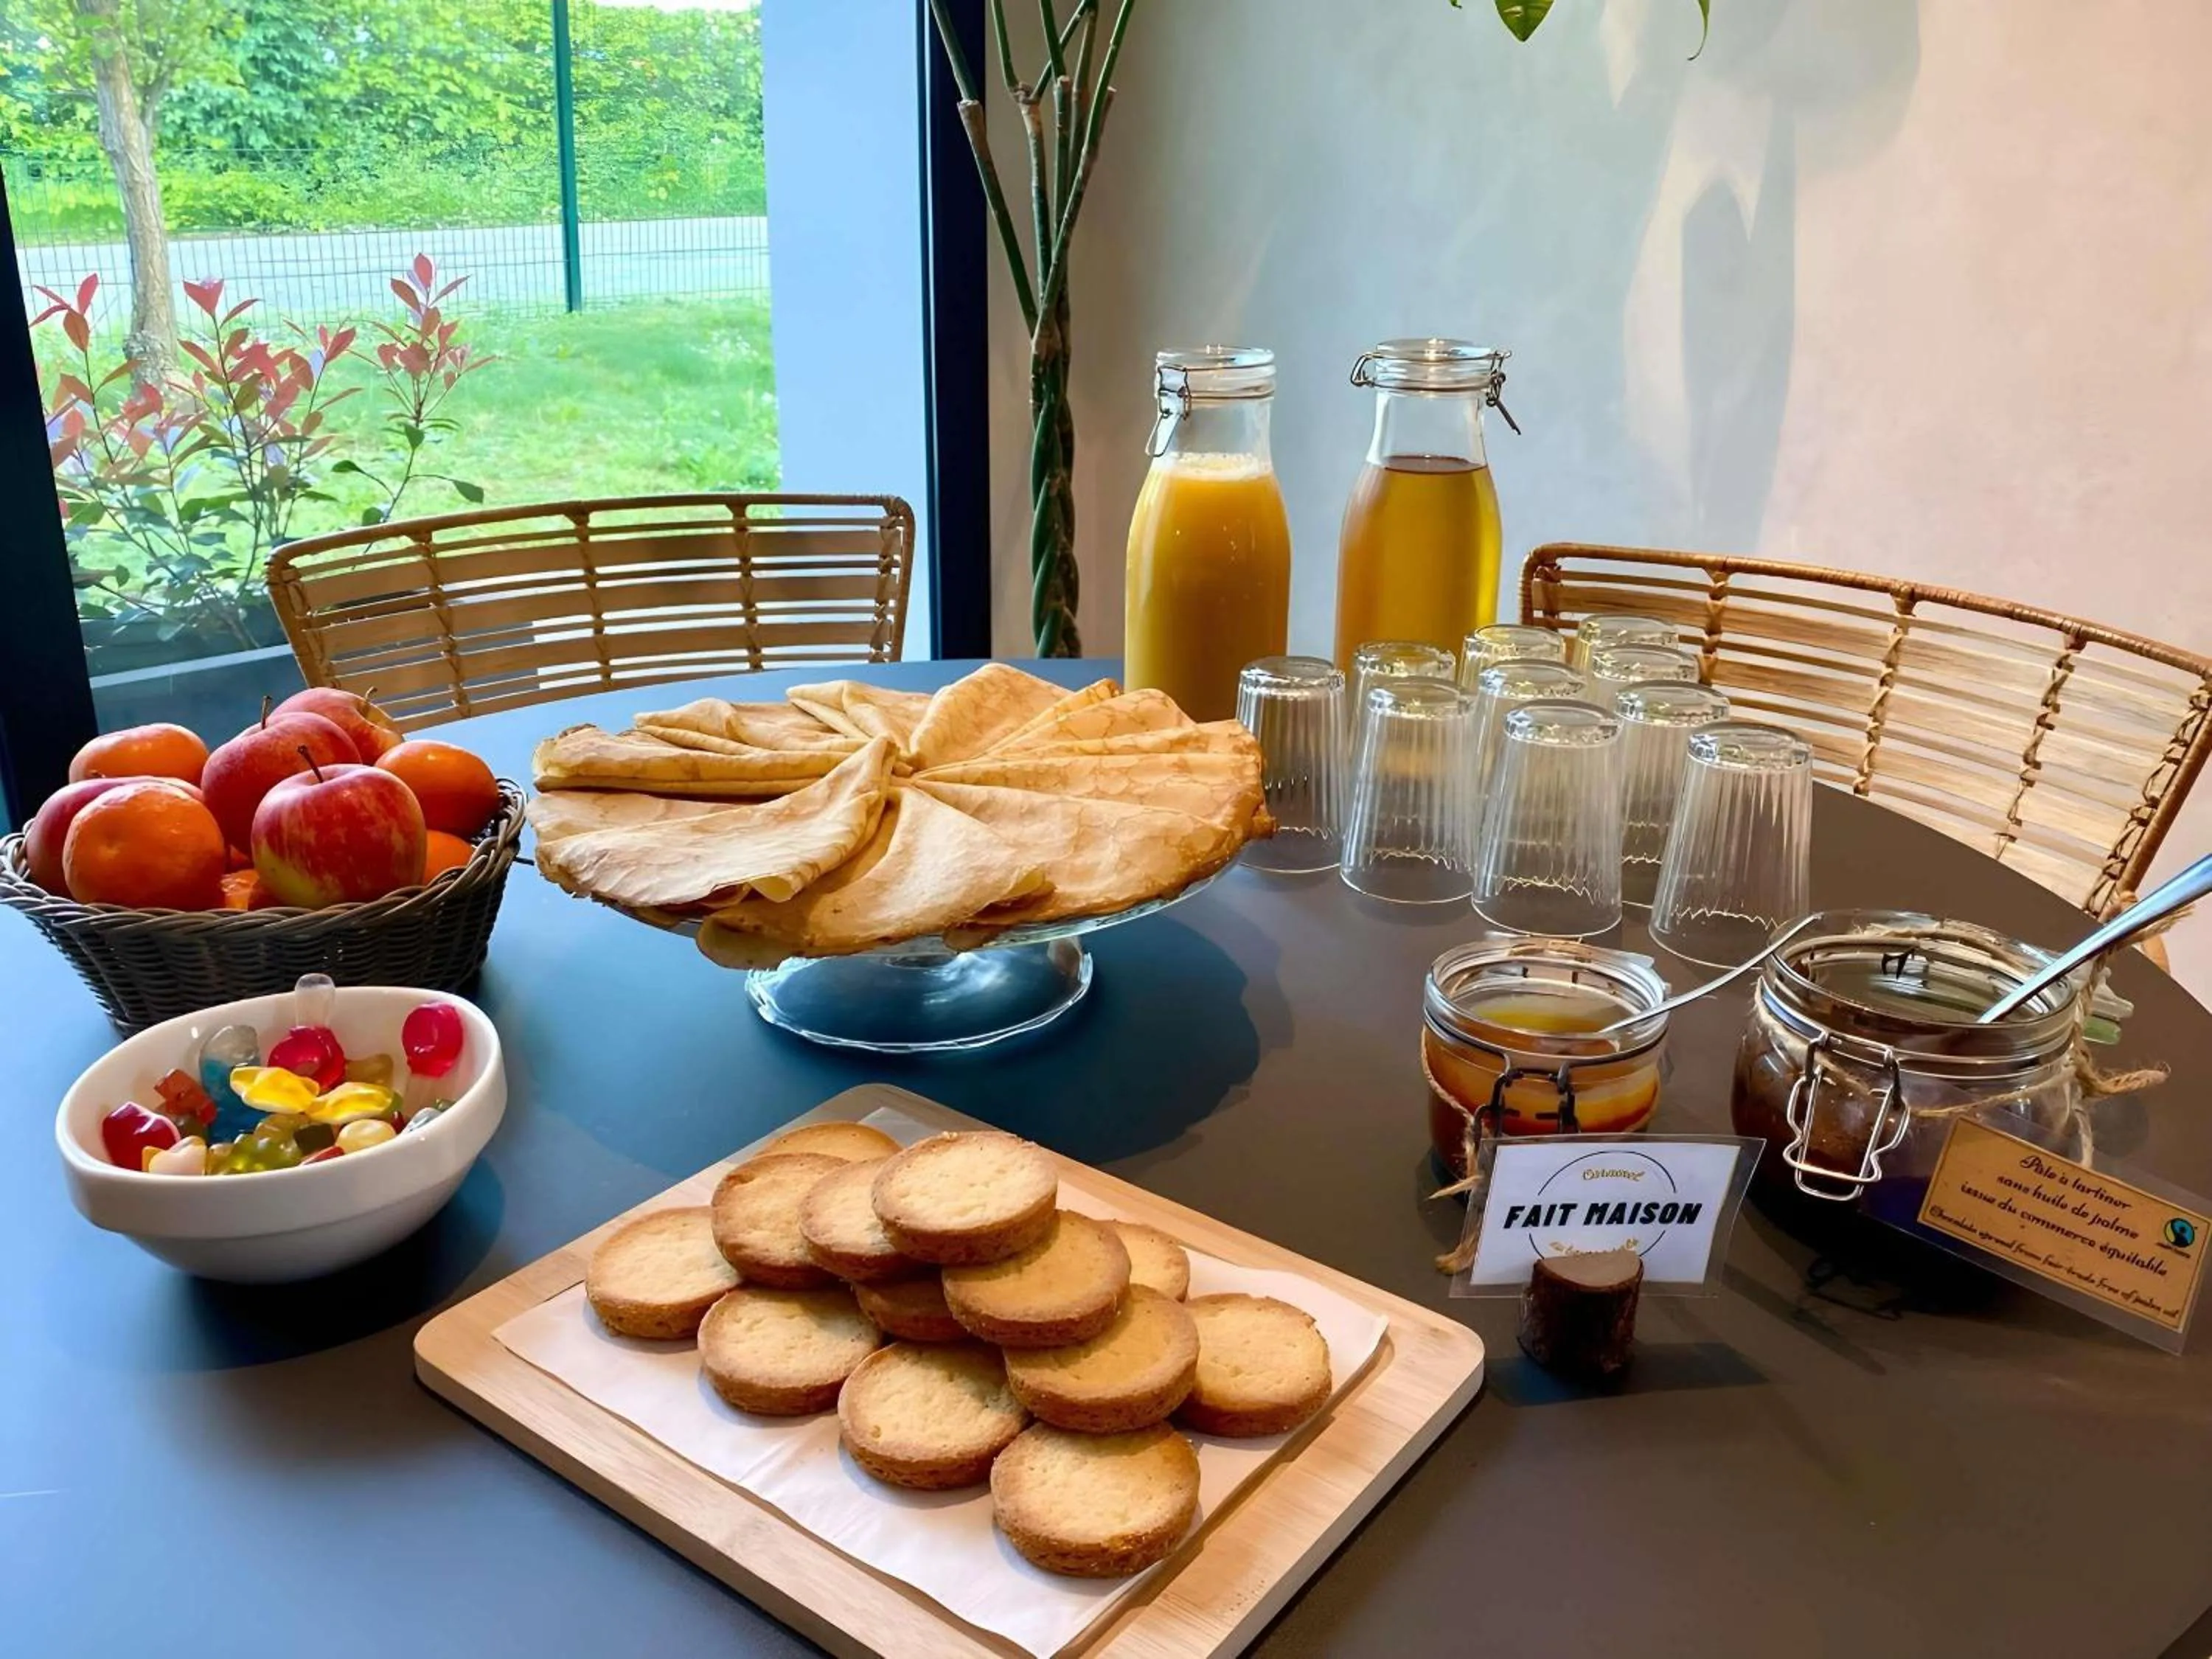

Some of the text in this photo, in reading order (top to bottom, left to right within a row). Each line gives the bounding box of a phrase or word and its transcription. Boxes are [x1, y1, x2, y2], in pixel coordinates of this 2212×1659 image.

[1996, 1175, 2140, 1239] sans huile de palme
[2072, 1178, 2132, 1209] tartiner
[1503, 1202, 1703, 1229] FAIT MAISON
[1997, 1197, 2017, 1214] du
[2020, 1211, 2096, 1248] commerce
